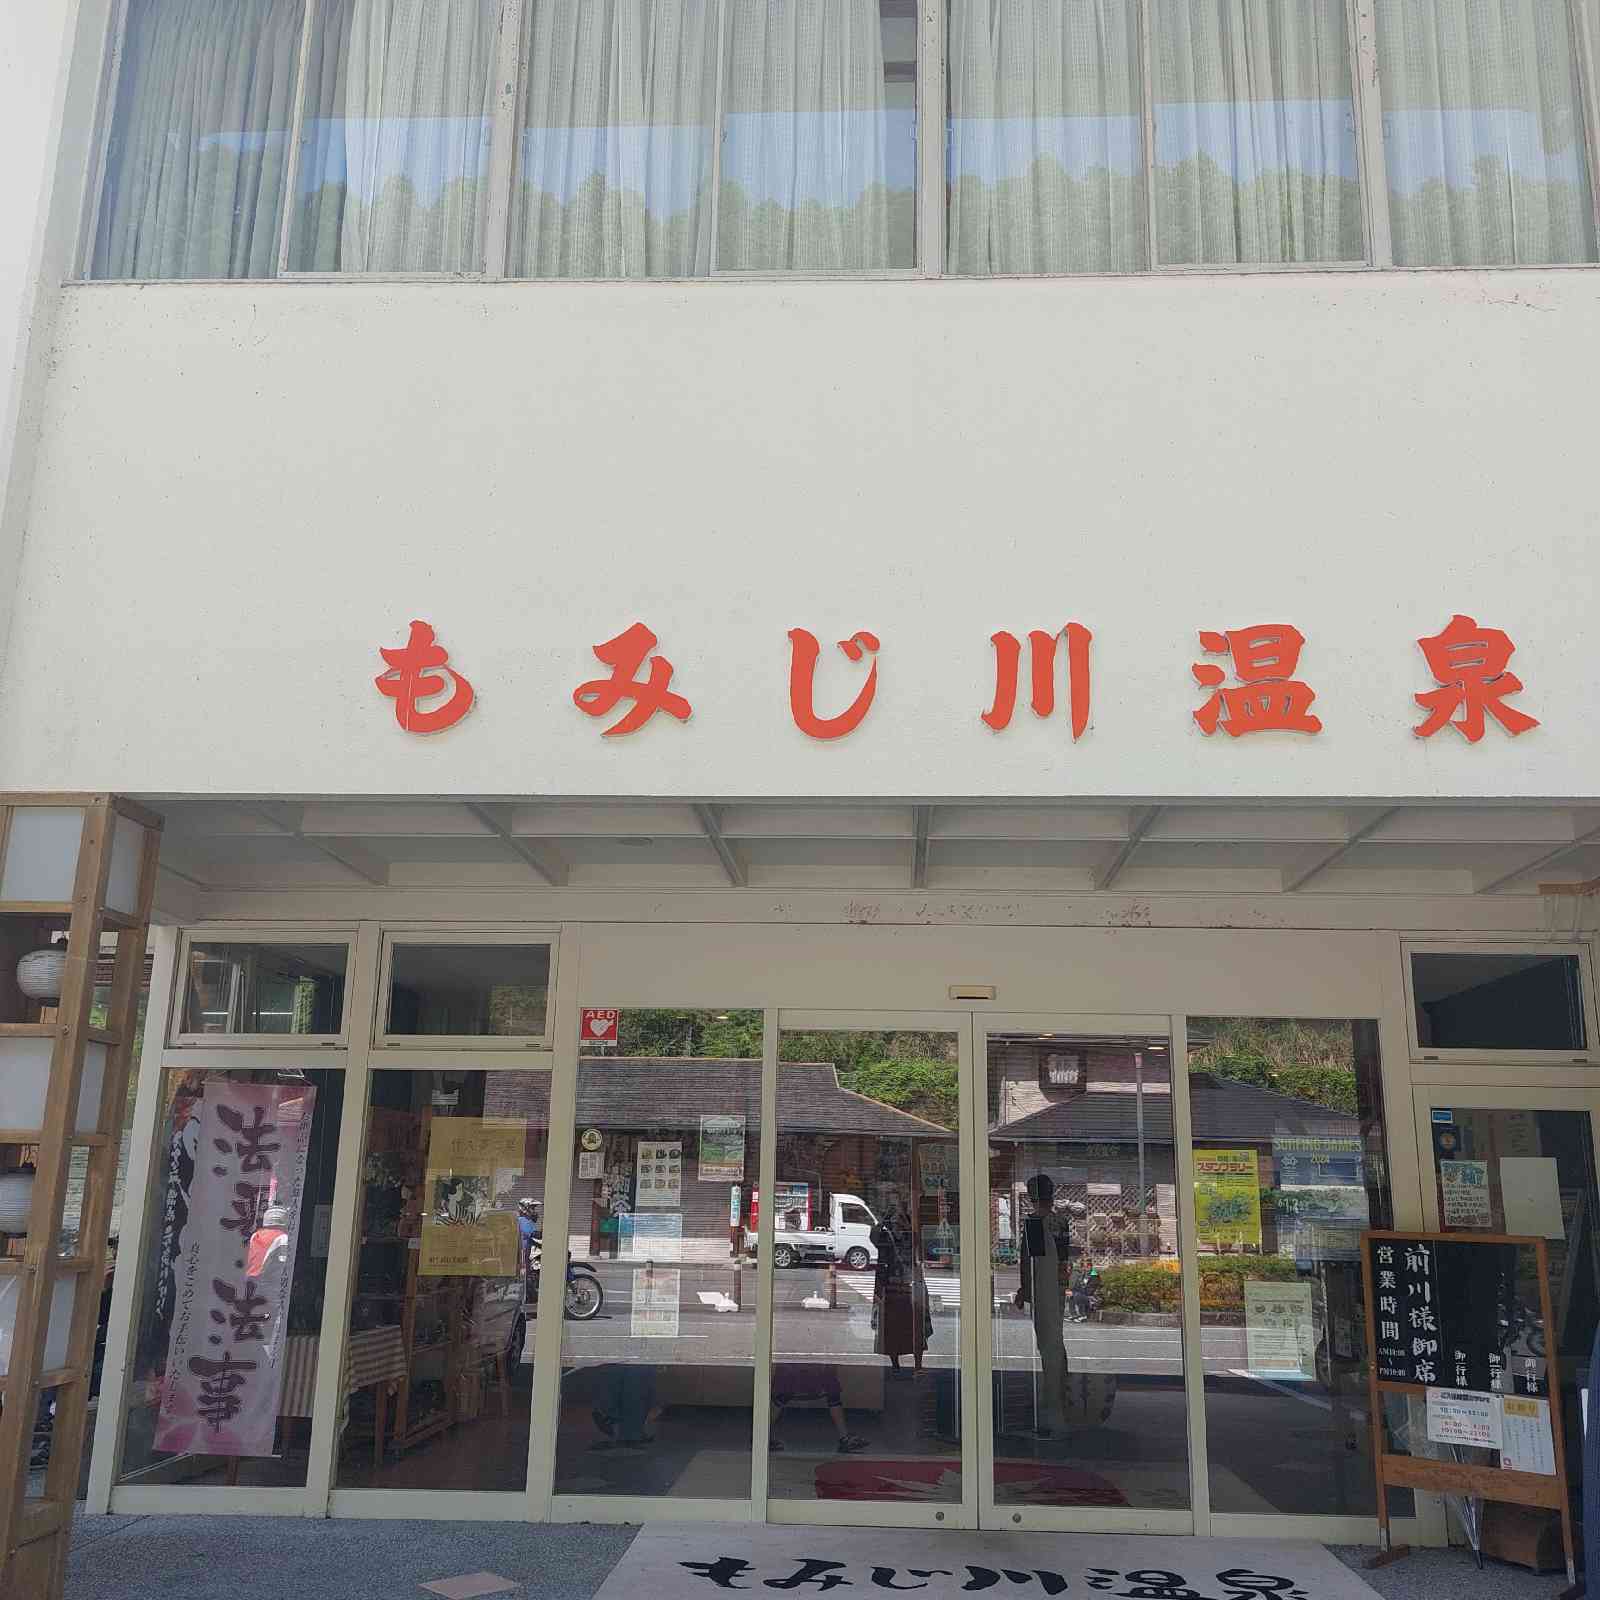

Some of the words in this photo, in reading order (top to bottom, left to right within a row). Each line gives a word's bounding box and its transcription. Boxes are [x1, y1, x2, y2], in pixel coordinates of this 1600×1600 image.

[375, 614, 1541, 743] もみじ川温泉
[584, 1010, 616, 1019] AED
[1197, 1162, 1254, 1172] スタンプラリー
[1377, 1246, 1399, 1341] 営業時間
[1404, 1243, 1438, 1384] 前川様御席
[679, 1556, 1310, 1600] もみじ川温泉
